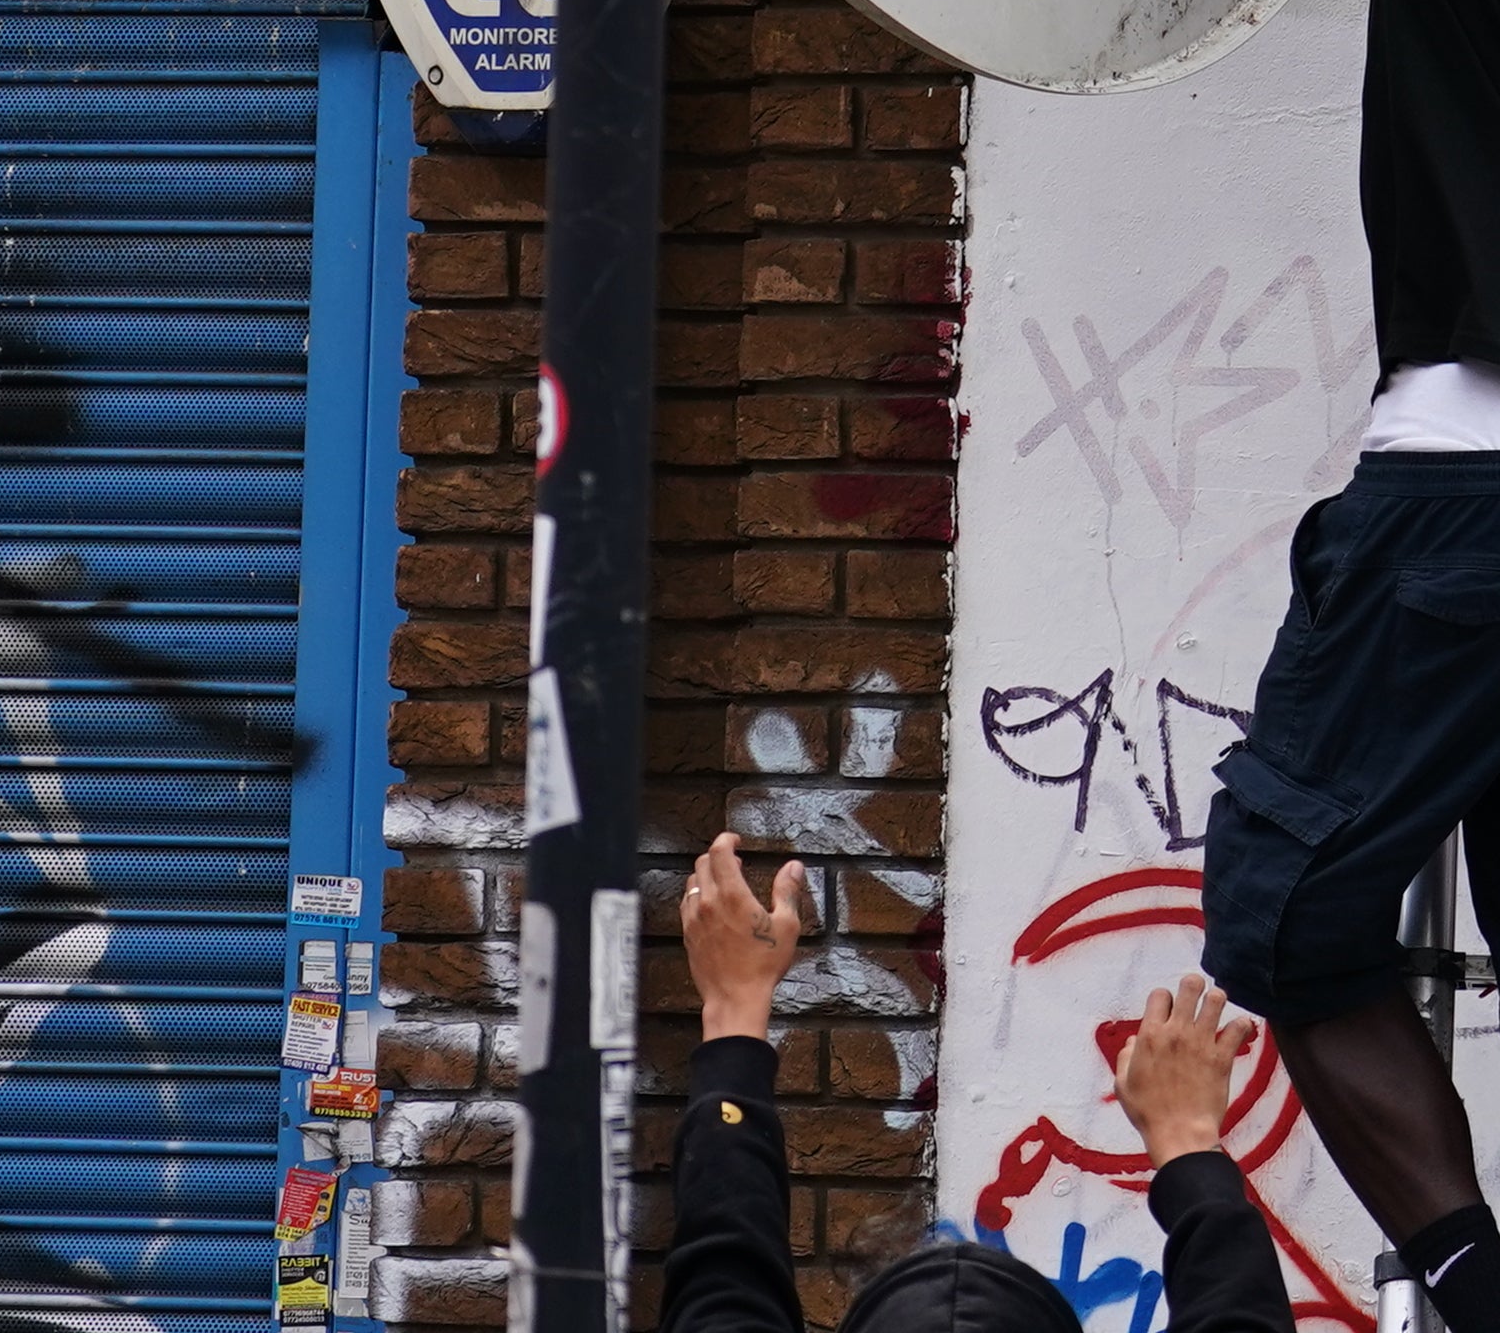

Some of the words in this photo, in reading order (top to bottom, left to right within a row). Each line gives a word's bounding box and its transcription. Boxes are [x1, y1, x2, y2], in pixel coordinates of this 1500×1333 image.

[450, 28, 562, 45] MONITORE
[475, 53, 551, 70] ALARM
[297, 876, 343, 887] UNIQUE
[293, 999, 311, 1013] FAST
[311, 1002, 339, 1018] SERVICE
[280, 1257, 321, 1267] RABBIT
